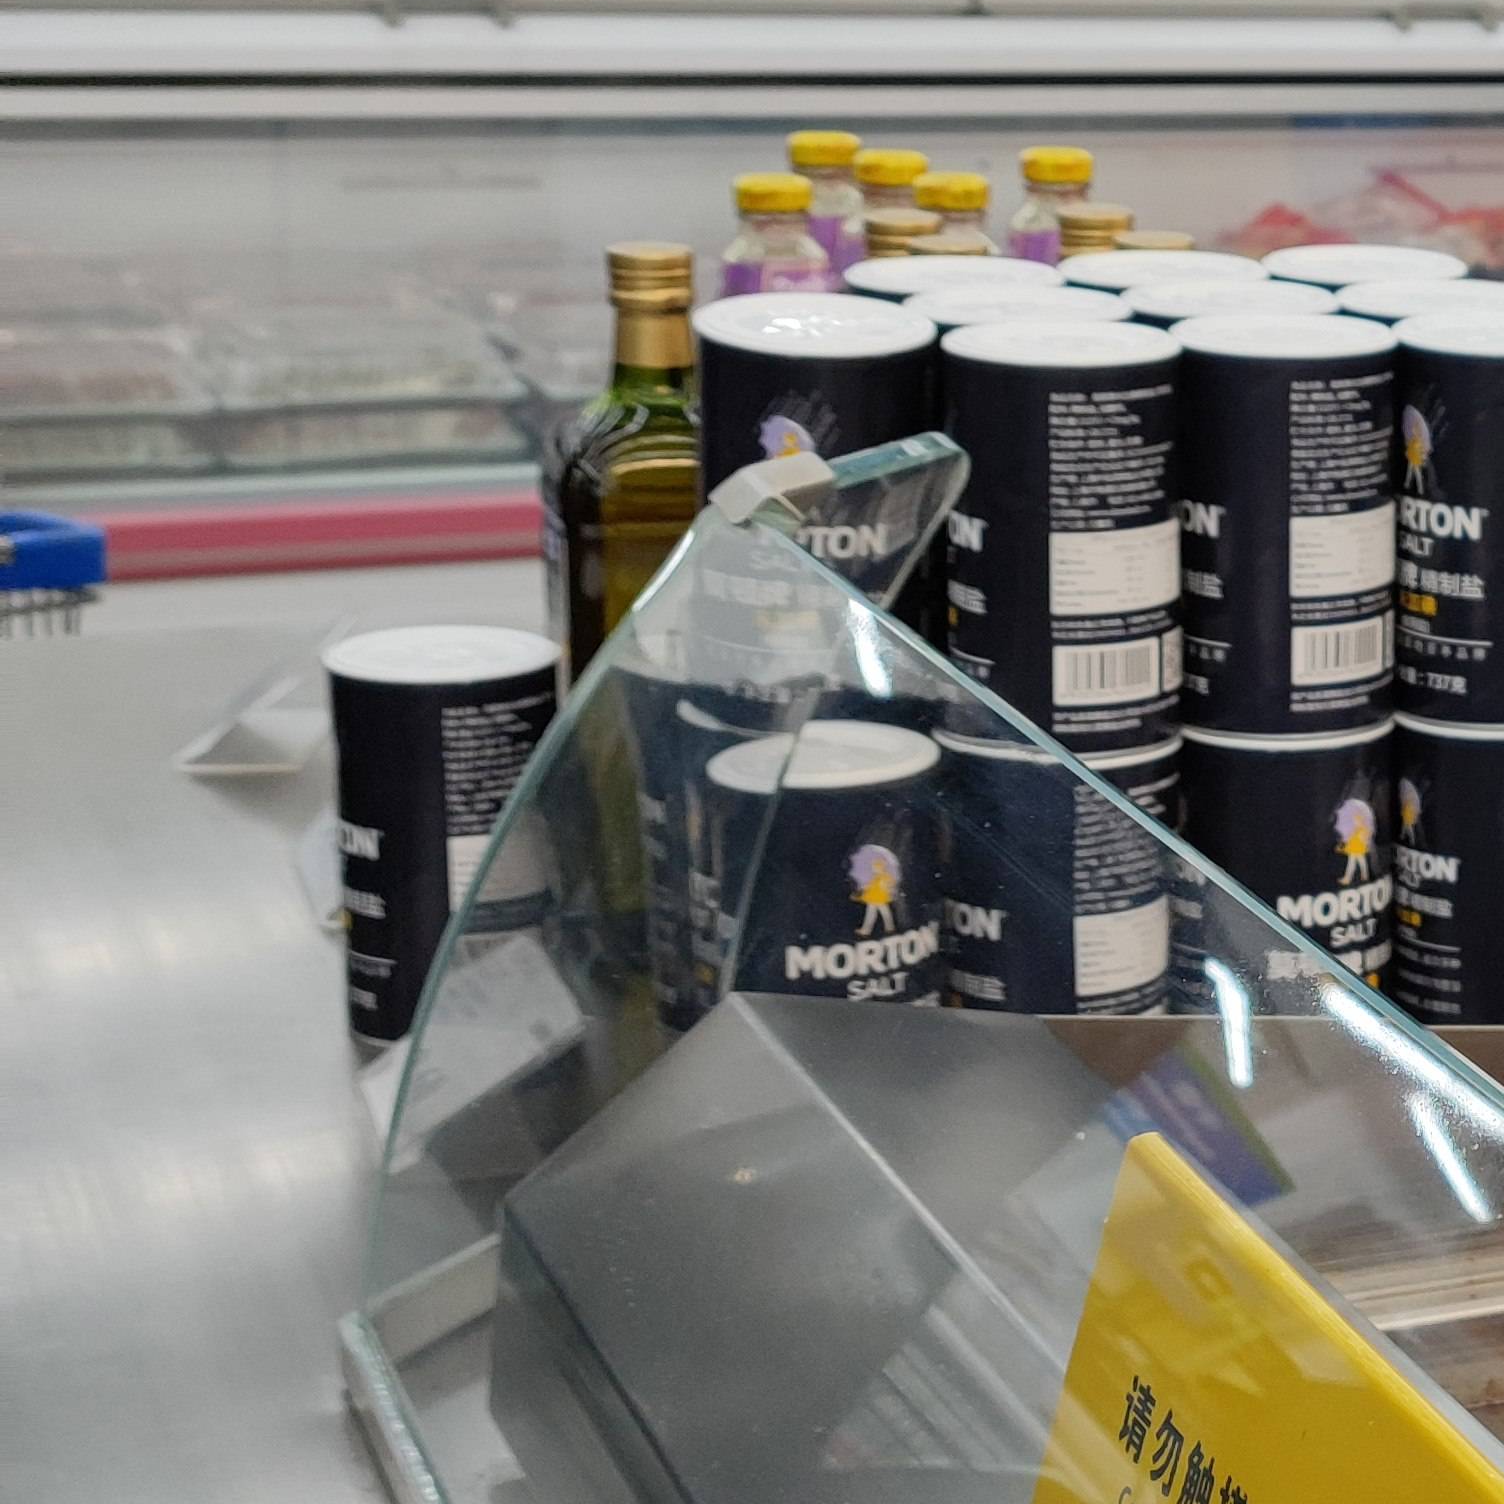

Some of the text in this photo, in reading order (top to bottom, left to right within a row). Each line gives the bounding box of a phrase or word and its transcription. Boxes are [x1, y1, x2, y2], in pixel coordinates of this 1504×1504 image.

[1402, 496, 1483, 540] RTON
[1276, 875, 1393, 929] MORTO
[784, 921, 939, 981] MORTON
[1330, 917, 1377, 947] SALT
[846, 971, 909, 1001] SALT
